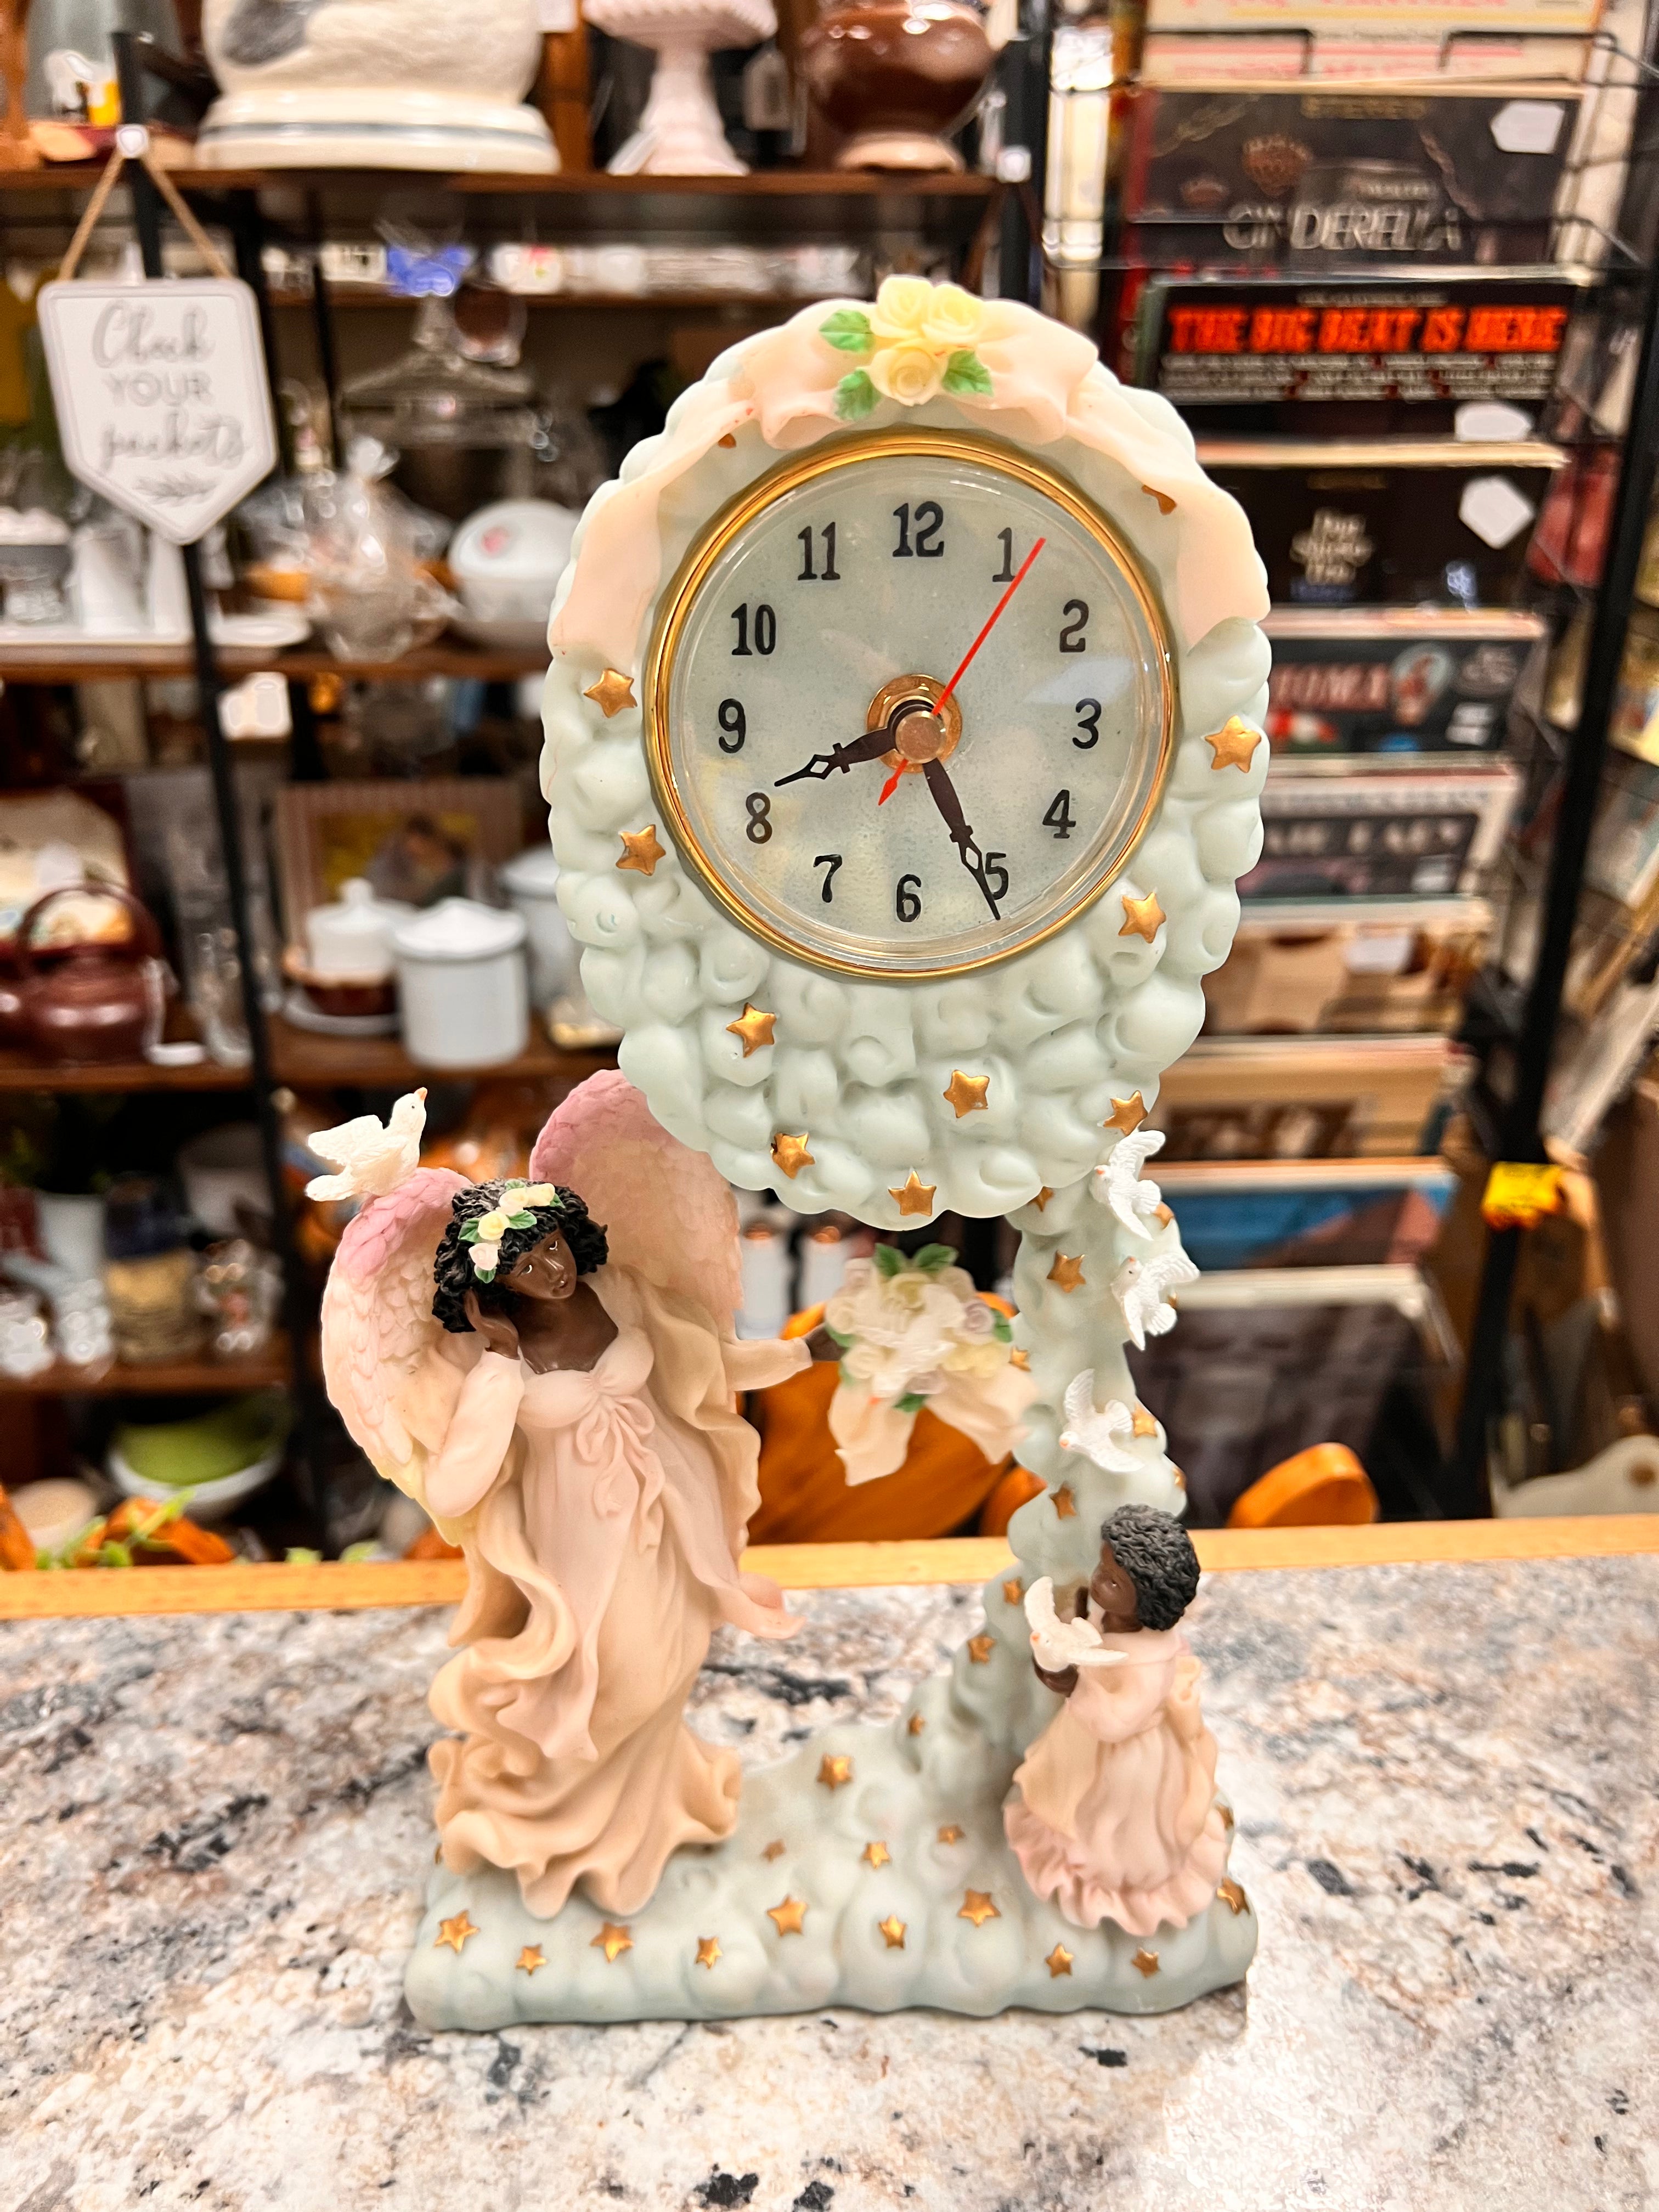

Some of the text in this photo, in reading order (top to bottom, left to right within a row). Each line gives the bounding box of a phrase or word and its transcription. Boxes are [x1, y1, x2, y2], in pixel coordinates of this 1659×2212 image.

[1169, 305, 1247, 353] THE
[1318, 306, 1421, 353] BEAT
[1422, 306, 1464, 352] IS
[1466, 305, 1568, 352] HERE
[101, 370, 215, 407] YOUR
[797, 521, 841, 581] 11
[892, 501, 945, 557] 12
[992, 527, 1016, 582] 1
[731, 602, 776, 656] 10
[1059, 599, 1089, 653] 2
[718, 698, 746, 754] 9
[1072, 698, 1102, 749] 3
[746, 792, 772, 844] 8
[1042, 789, 1076, 839] 4
[813, 854, 843, 903] 7
[895, 874, 922, 923] 6
[985, 852, 1009, 900] 5
